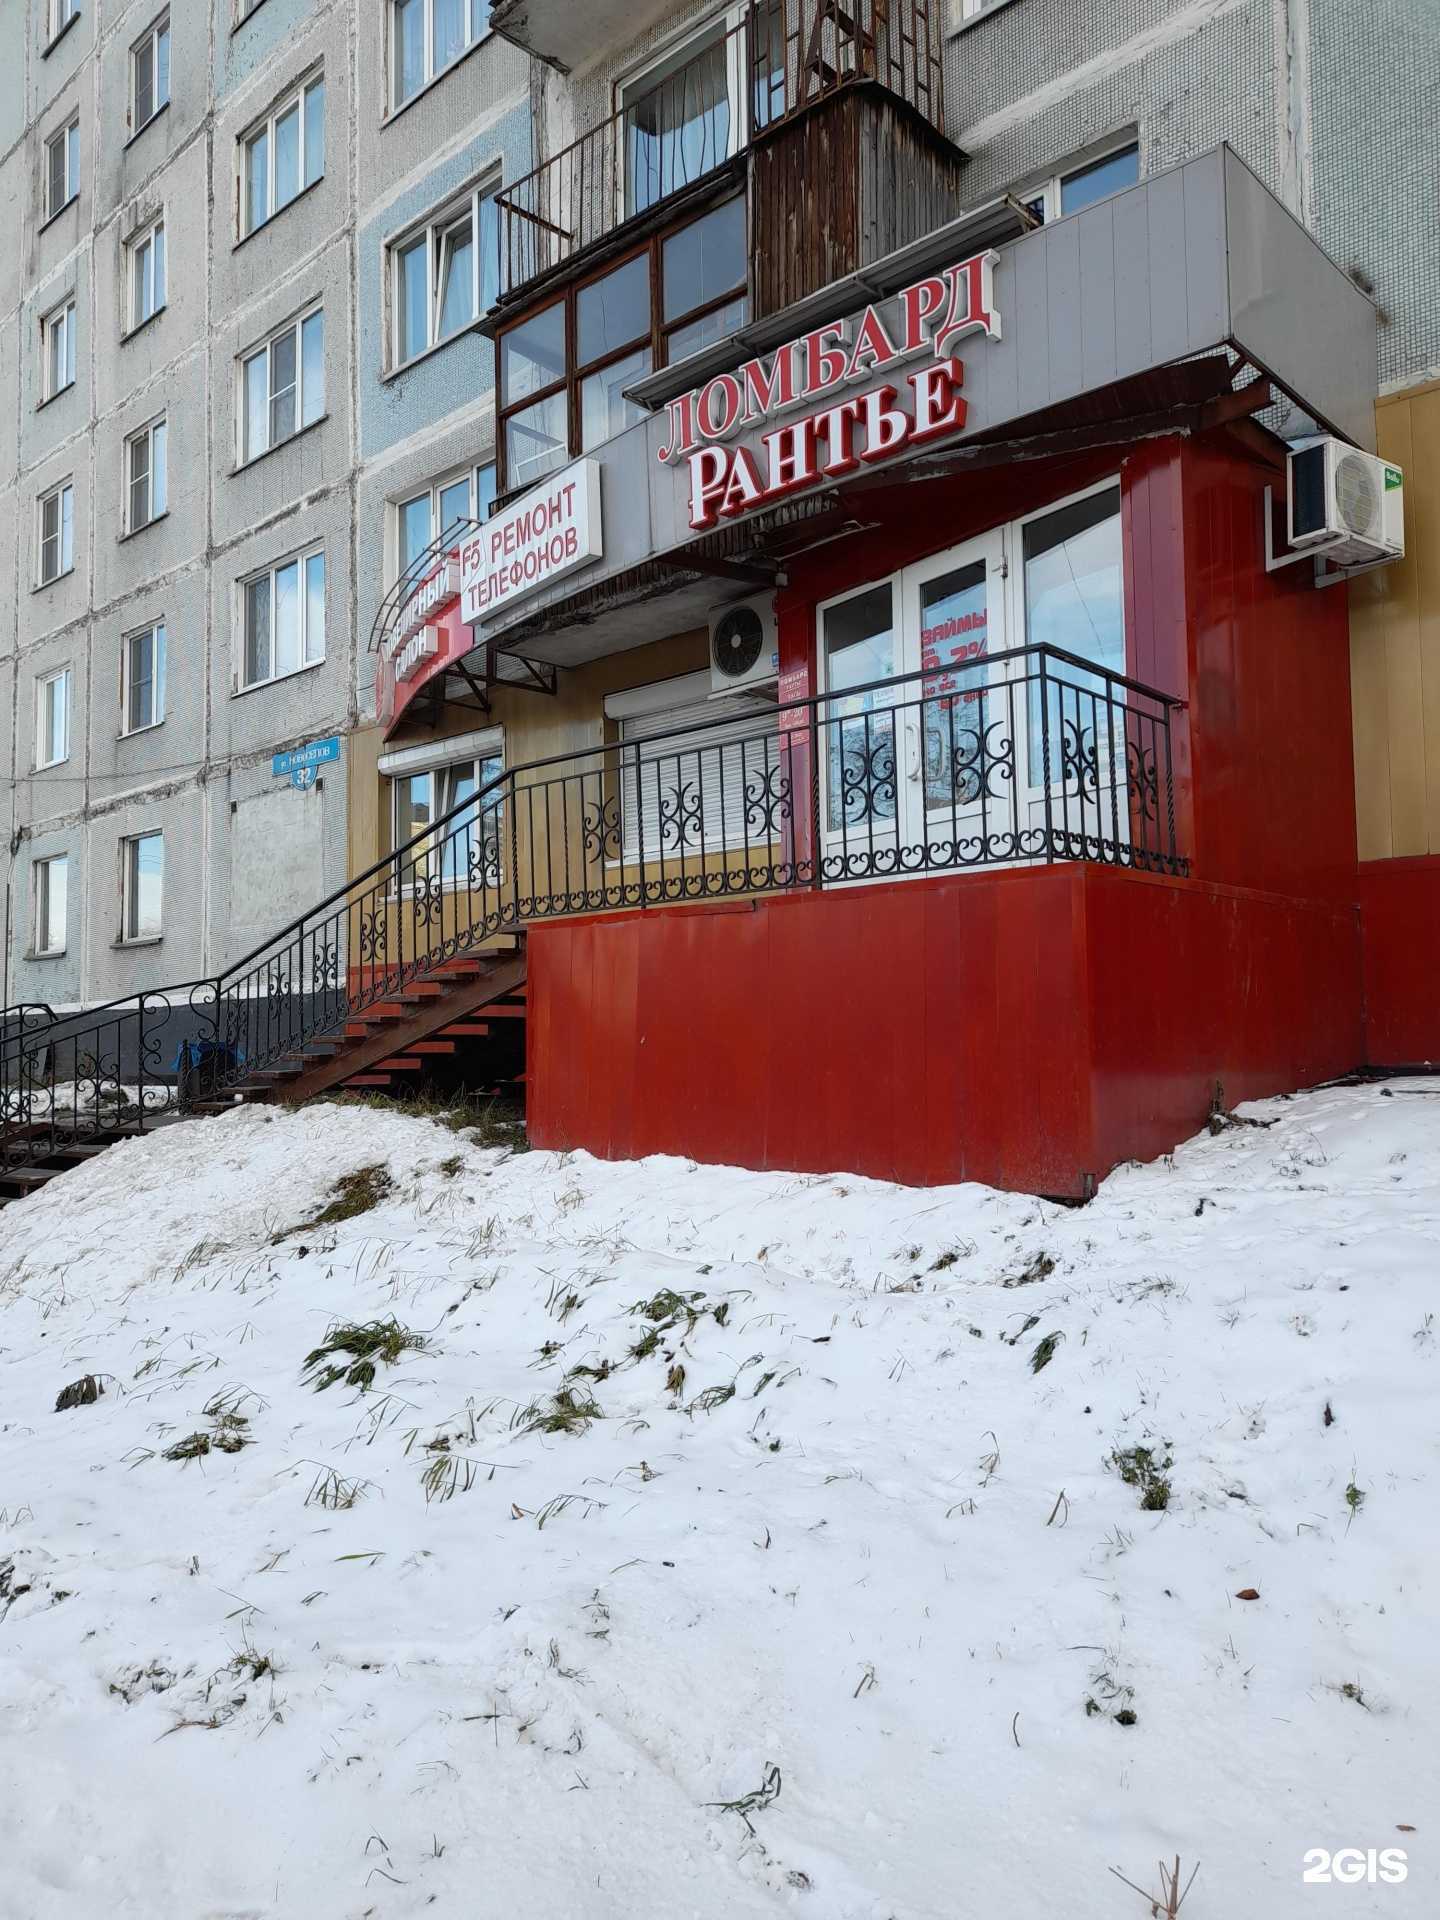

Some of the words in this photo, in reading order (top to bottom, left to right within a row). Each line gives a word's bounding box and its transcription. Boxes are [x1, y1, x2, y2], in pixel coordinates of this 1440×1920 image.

[657, 249, 1001, 465] ЛОМБАРД
[687, 356, 968, 529] РАНТЬЕ
[491, 482, 576, 563] РЕМОНТ
[468, 527, 578, 612] ТЕЛЕФОНОВ
[921, 608, 987, 645] ЗАЙМЫ
[297, 768, 311, 784] 32
